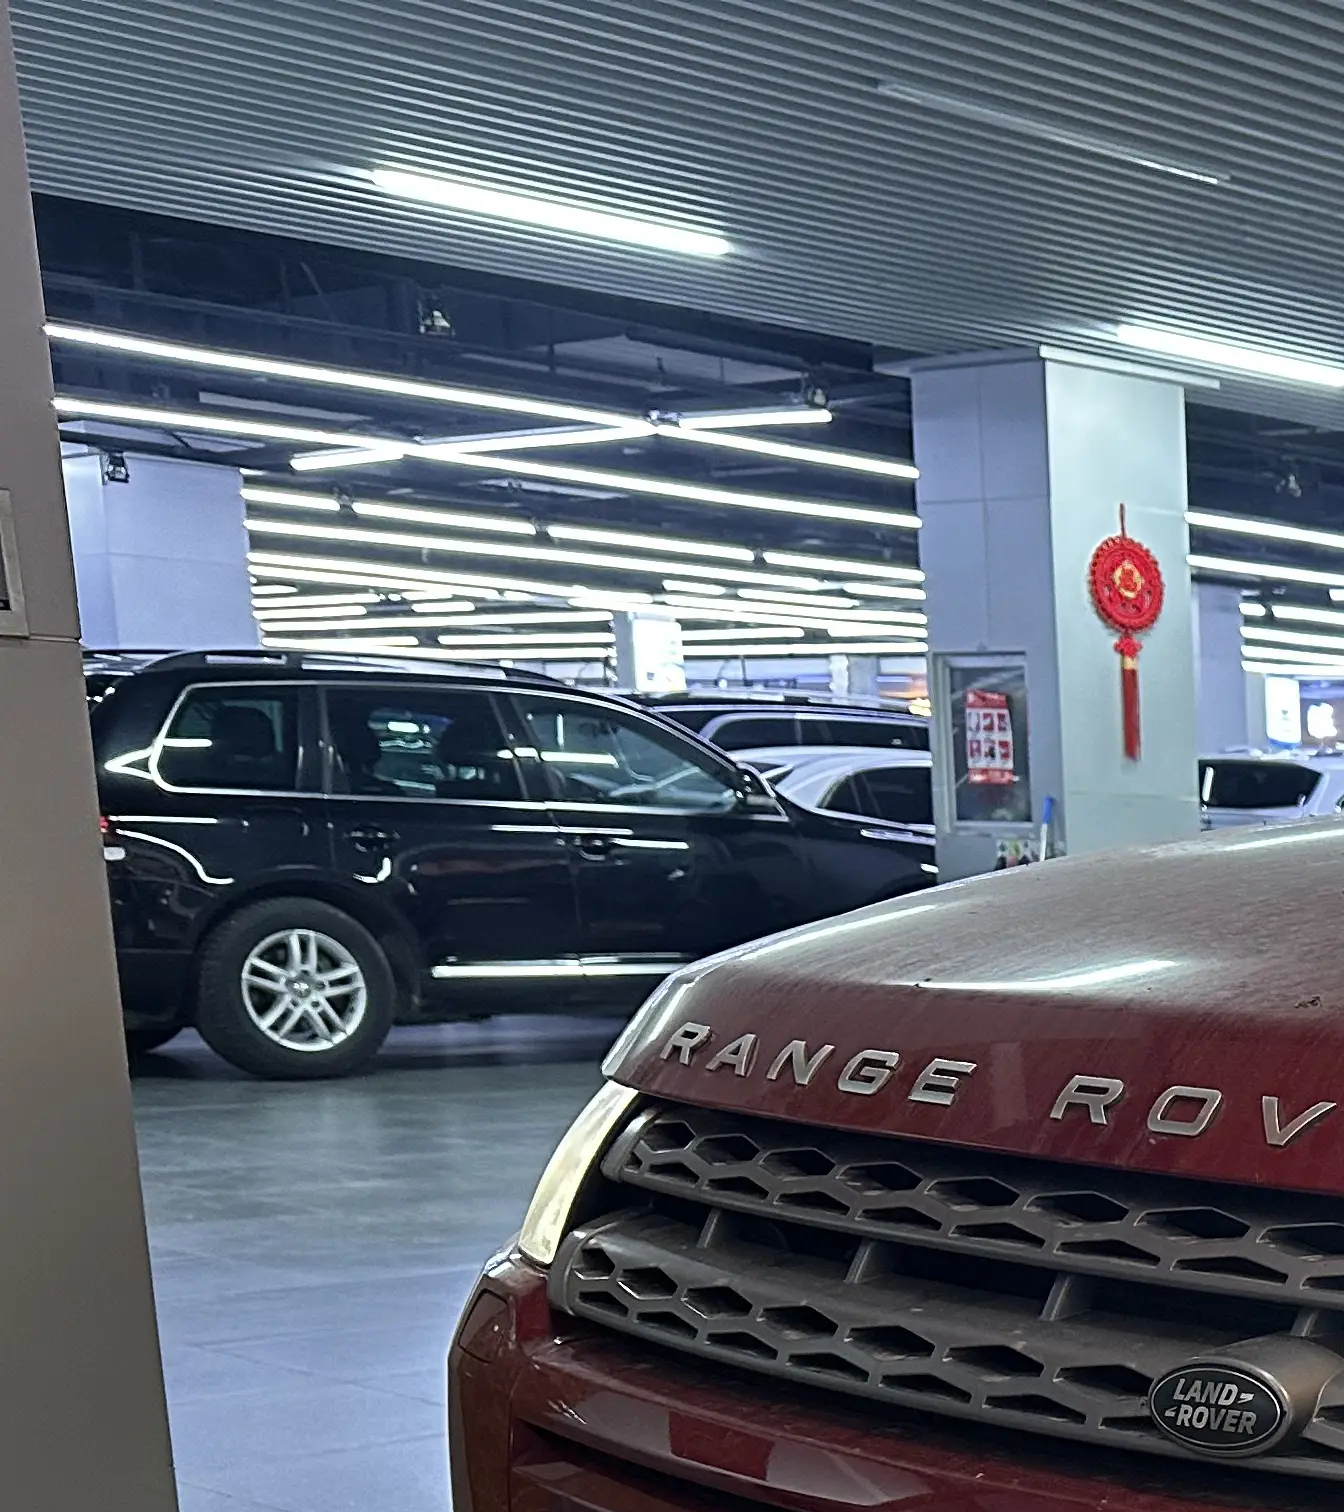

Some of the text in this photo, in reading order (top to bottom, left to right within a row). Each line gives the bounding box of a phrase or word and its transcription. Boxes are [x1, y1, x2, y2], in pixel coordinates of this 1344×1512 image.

[659, 1021, 977, 1107] RANGE
[1173, 1378, 1239, 1406] LAND
[1175, 1404, 1257, 1435] ROVER
